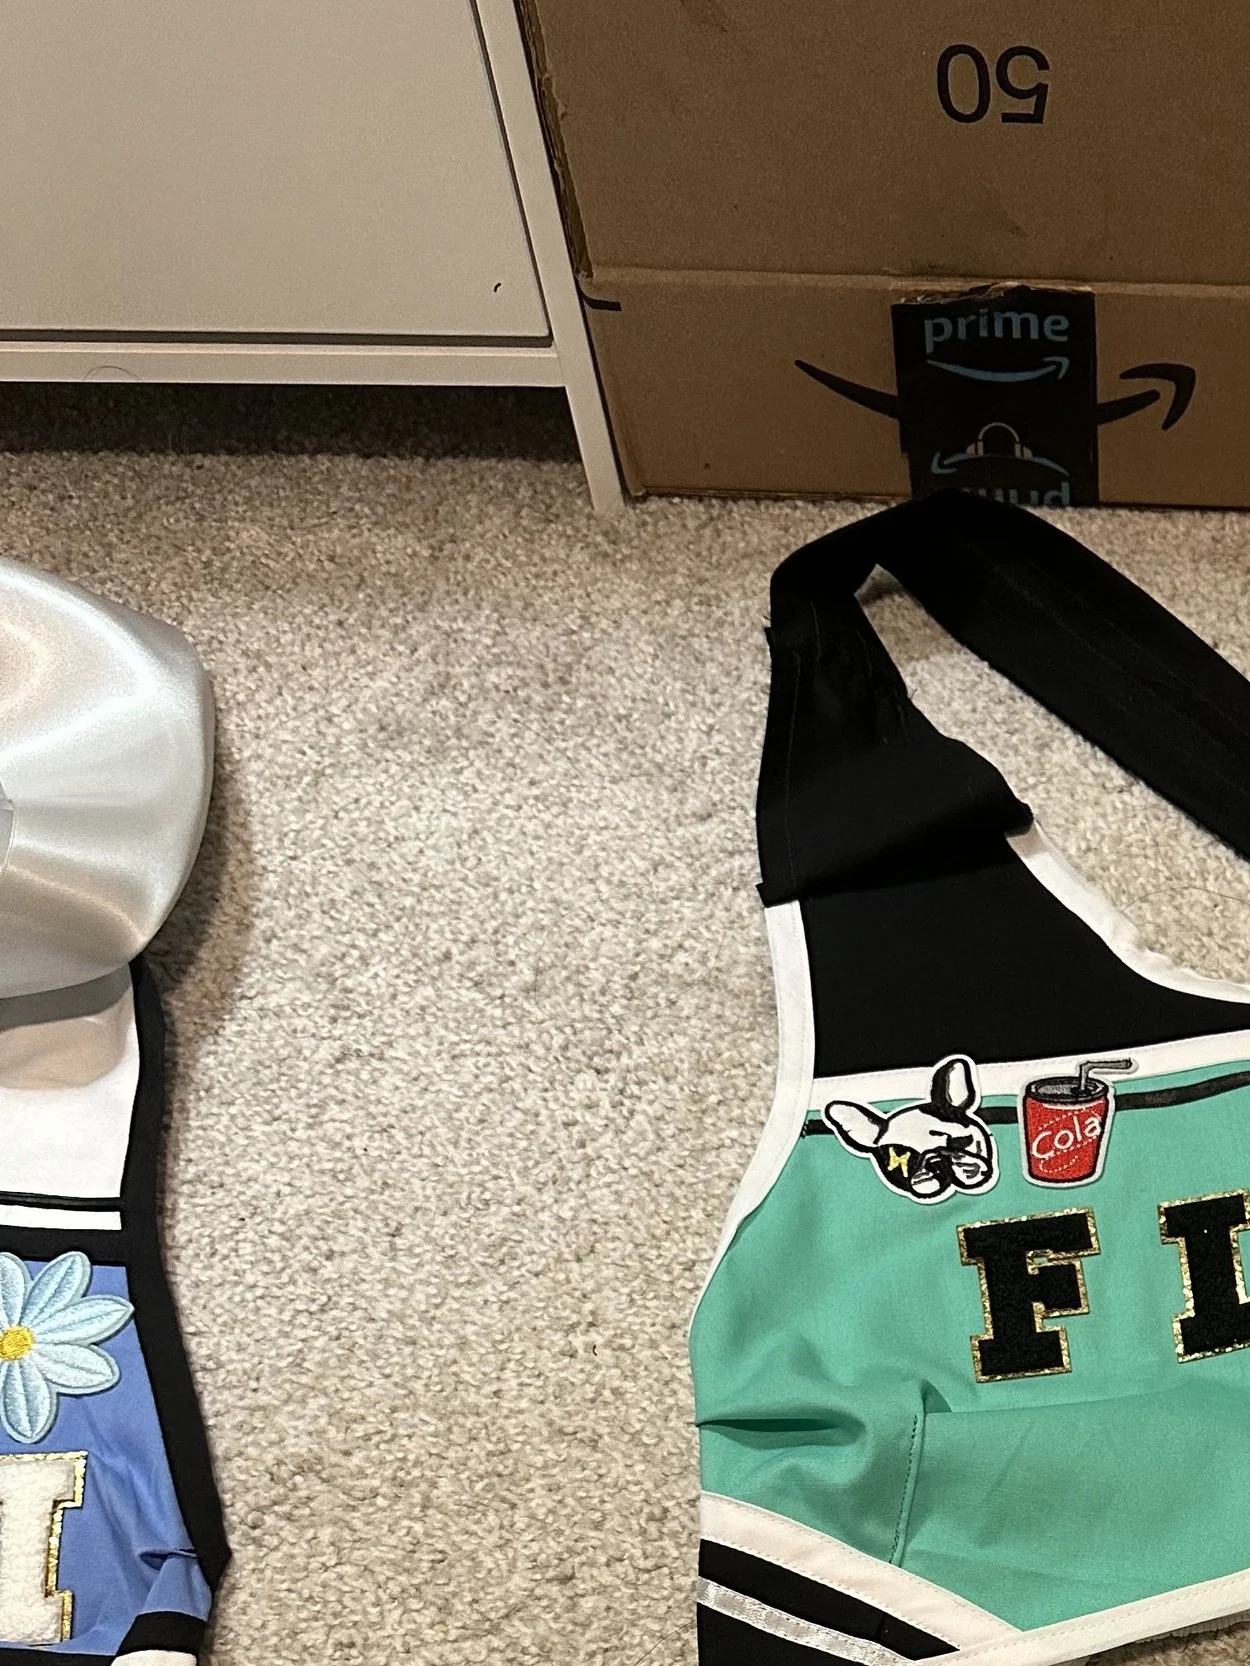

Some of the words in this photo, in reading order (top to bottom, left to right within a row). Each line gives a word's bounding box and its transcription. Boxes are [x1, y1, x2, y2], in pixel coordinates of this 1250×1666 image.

[937, 43, 1050, 124] 50
[924, 308, 1070, 354] prime
[1031, 1115, 1102, 1160] Cola
